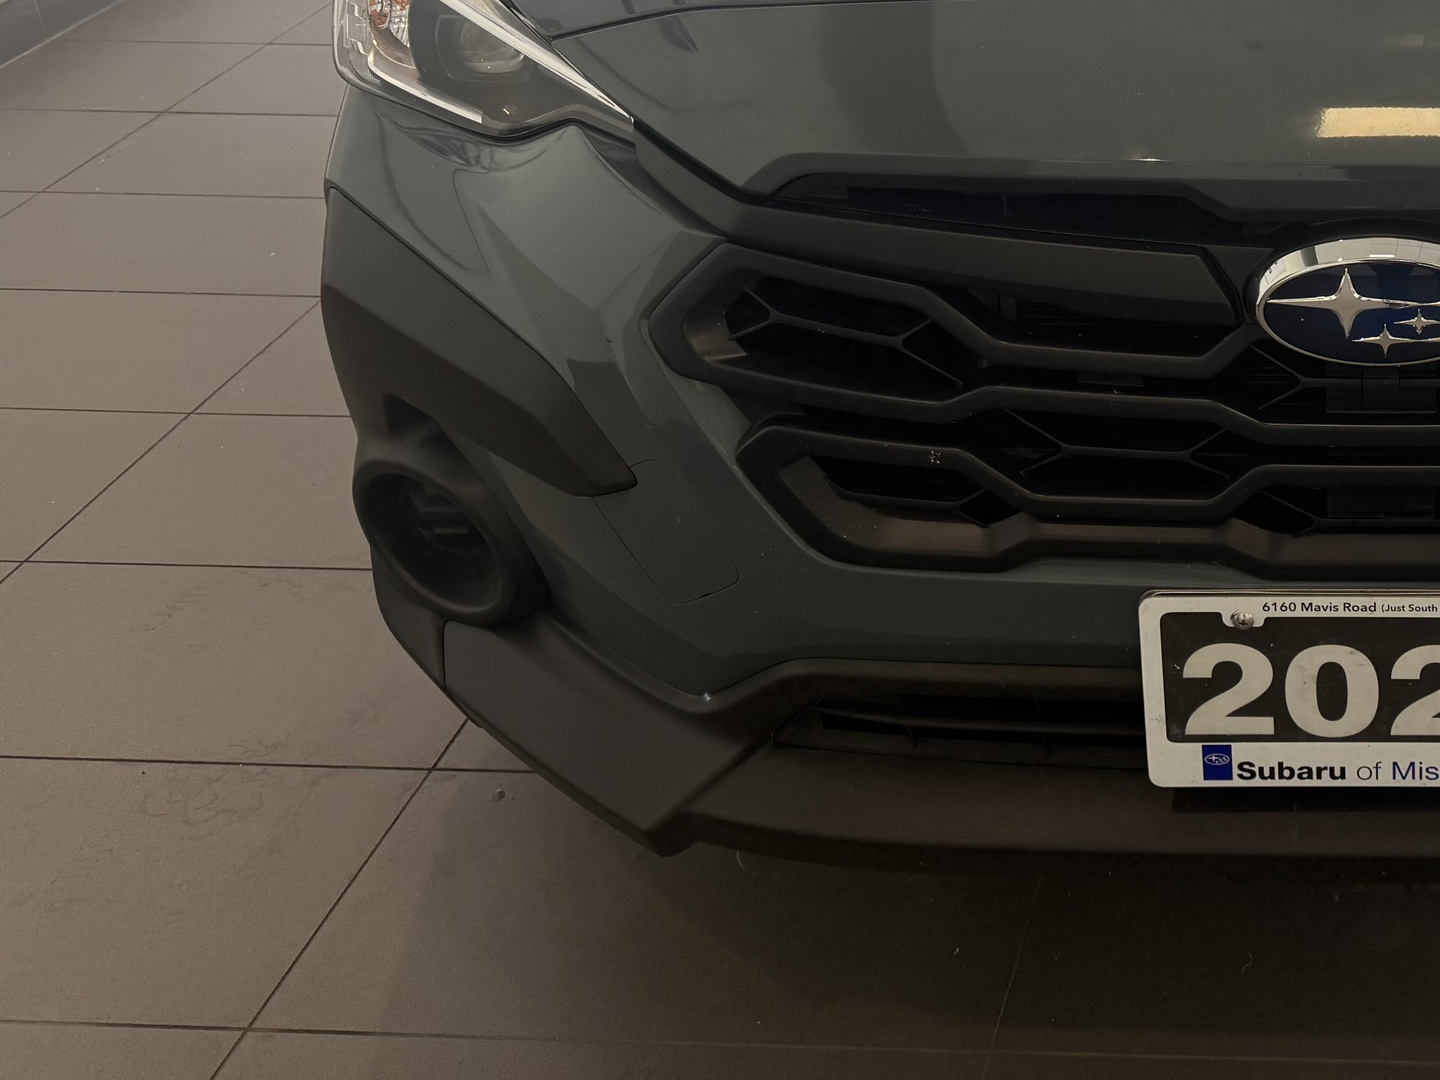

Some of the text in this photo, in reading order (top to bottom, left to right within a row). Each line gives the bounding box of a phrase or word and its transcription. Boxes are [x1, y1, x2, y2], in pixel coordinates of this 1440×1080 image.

[1262, 602, 1297, 612] 6160
[1301, 602, 1339, 612] Mavis
[1343, 602, 1377, 612] Road
[1381, 604, 1406, 613] (Just
[1408, 604, 1438, 613] South
[1236, 761, 1346, 780] Subaru
[1356, 761, 1382, 780] of
